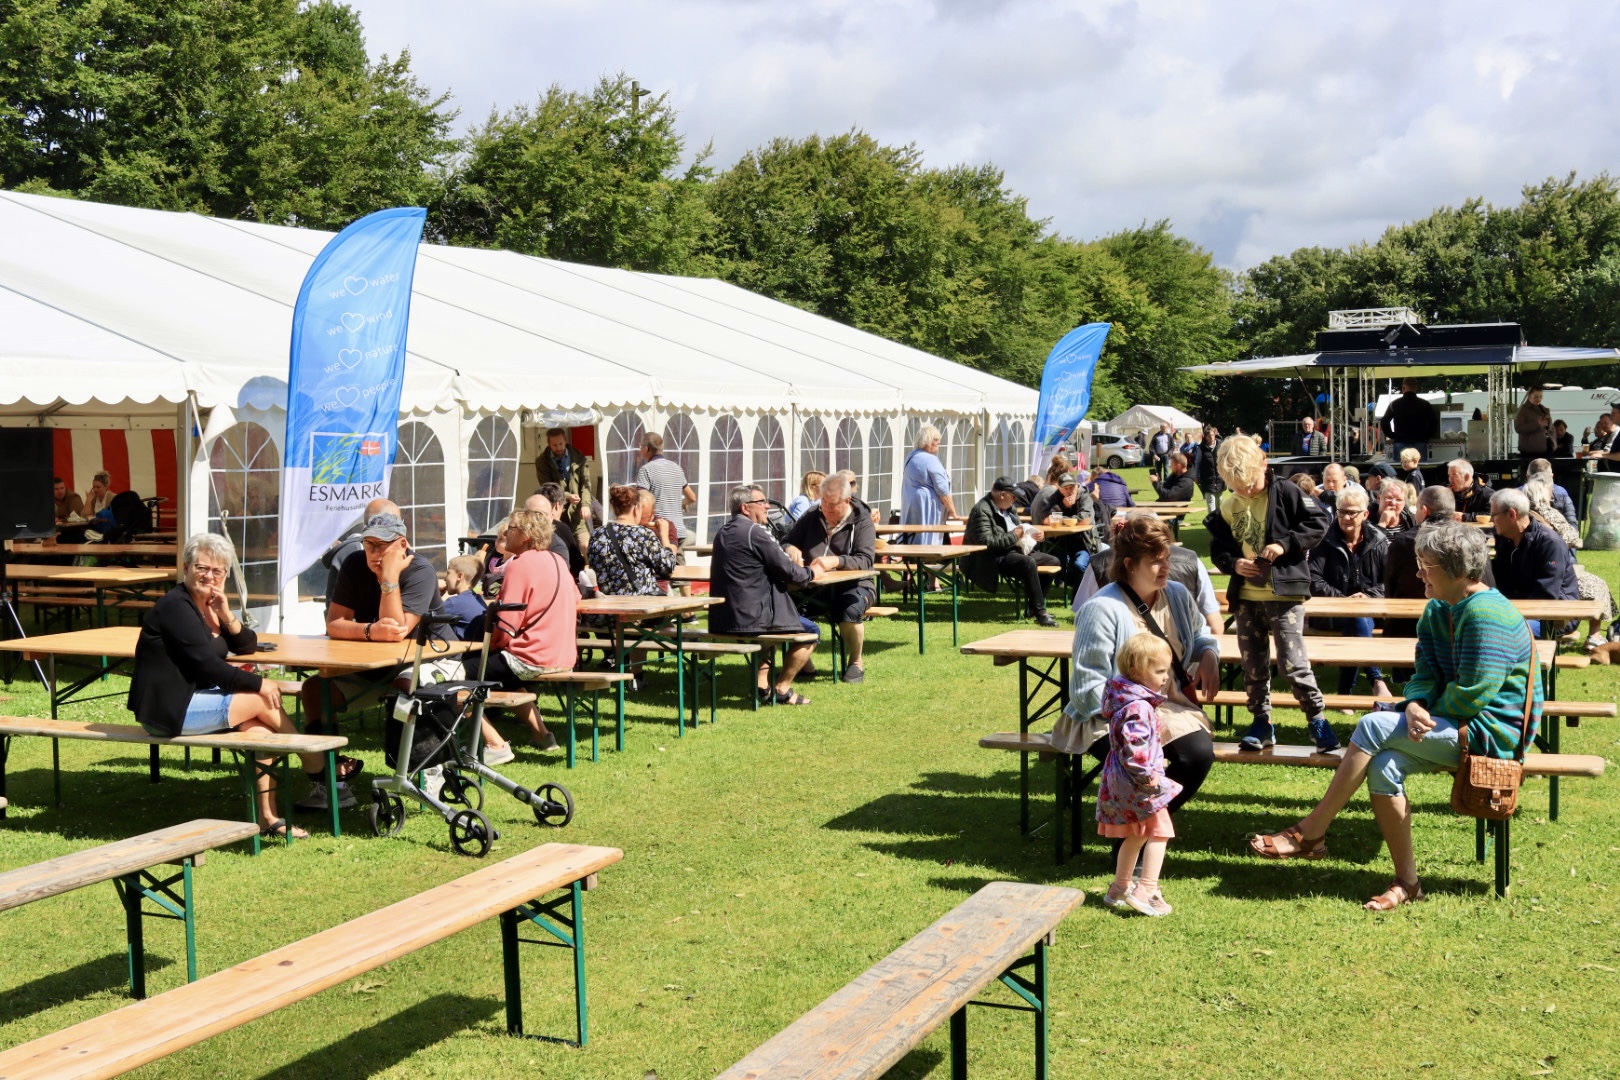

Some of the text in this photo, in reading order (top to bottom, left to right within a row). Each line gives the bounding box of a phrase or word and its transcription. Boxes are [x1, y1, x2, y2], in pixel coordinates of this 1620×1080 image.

[329, 272, 400, 300] we water
[327, 309, 393, 336] we wind
[324, 343, 398, 374] we nature
[321, 377, 397, 413] we people
[309, 482, 383, 501] ESMARK
